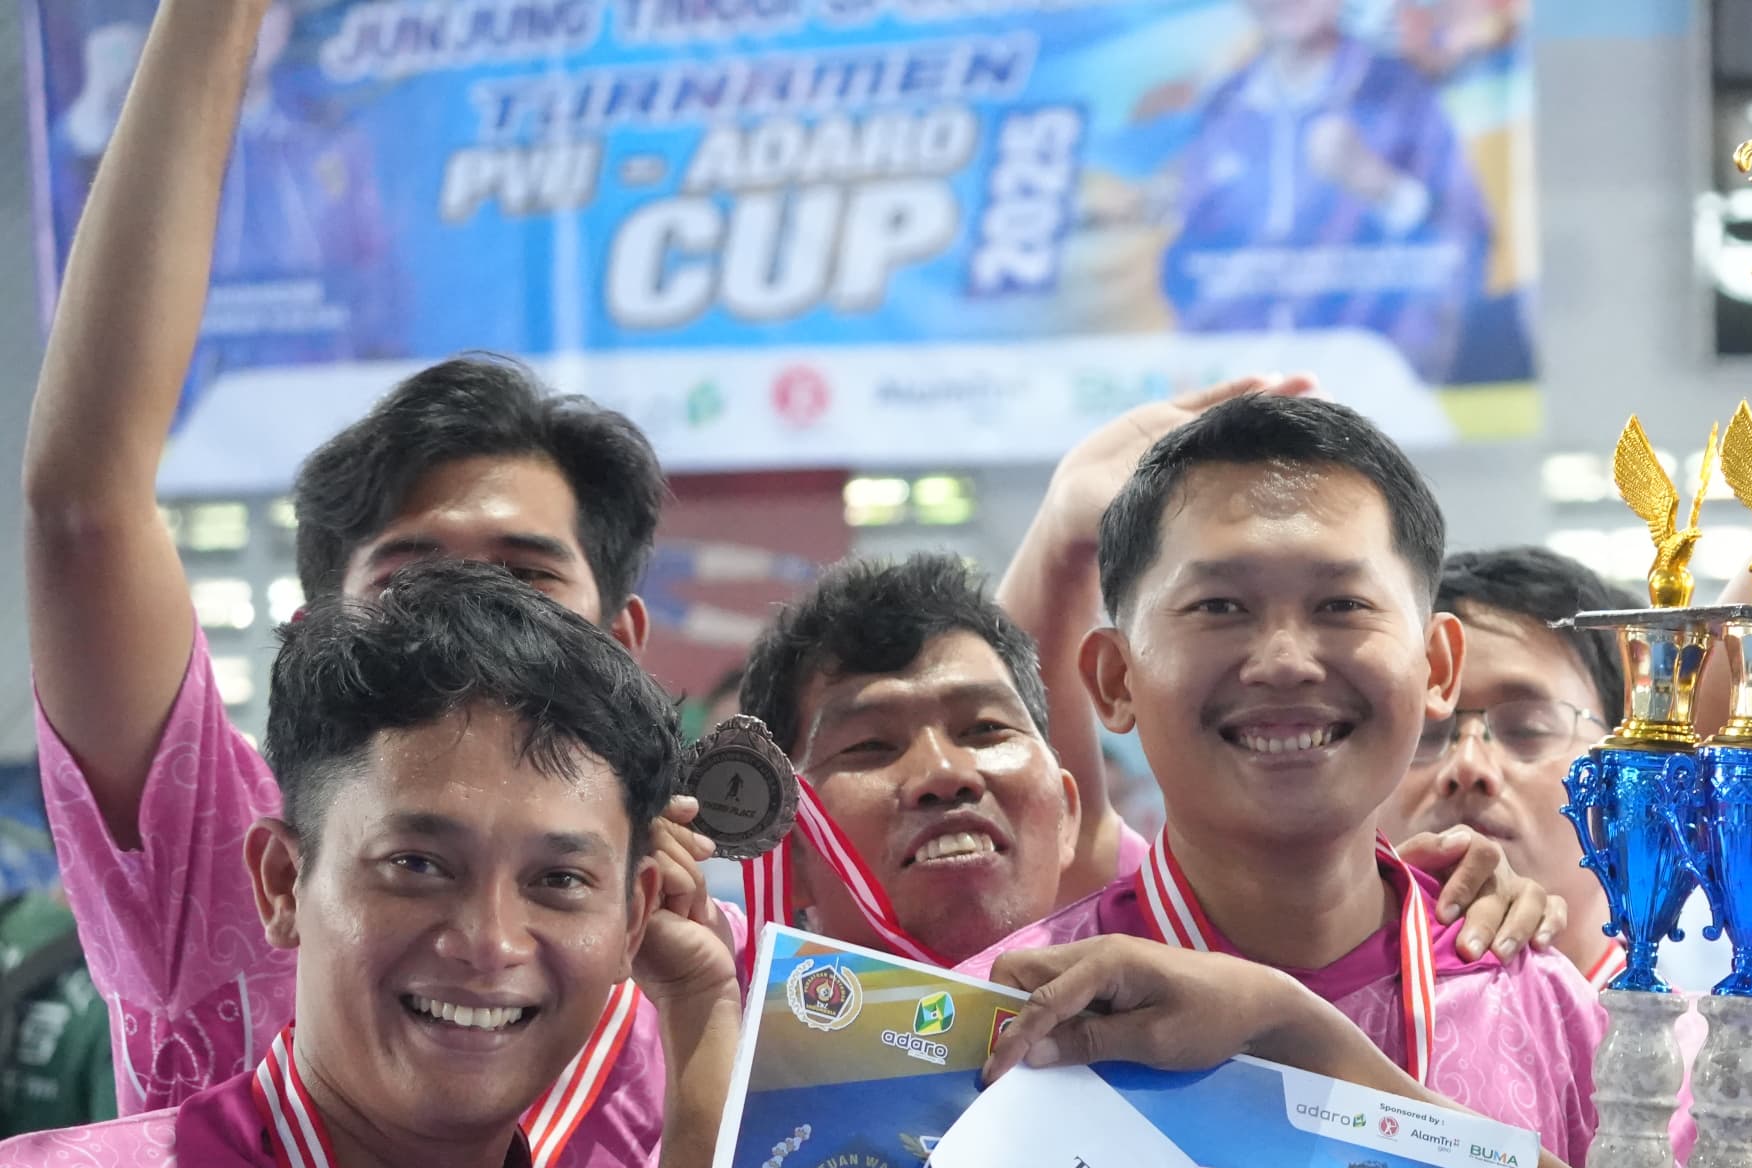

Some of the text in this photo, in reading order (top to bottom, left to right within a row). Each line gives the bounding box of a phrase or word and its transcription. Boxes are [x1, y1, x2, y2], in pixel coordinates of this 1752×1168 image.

[976, 106, 1086, 296] 2025
[608, 178, 958, 330] CUP
[882, 1030, 948, 1058] adaro
[1296, 1102, 1351, 1126] adaro
[1379, 1102, 1427, 1121] Sponsored
[1429, 1116, 1440, 1126] by
[1410, 1128, 1453, 1148] AlamTri
[1470, 1144, 1519, 1167] BUMA
